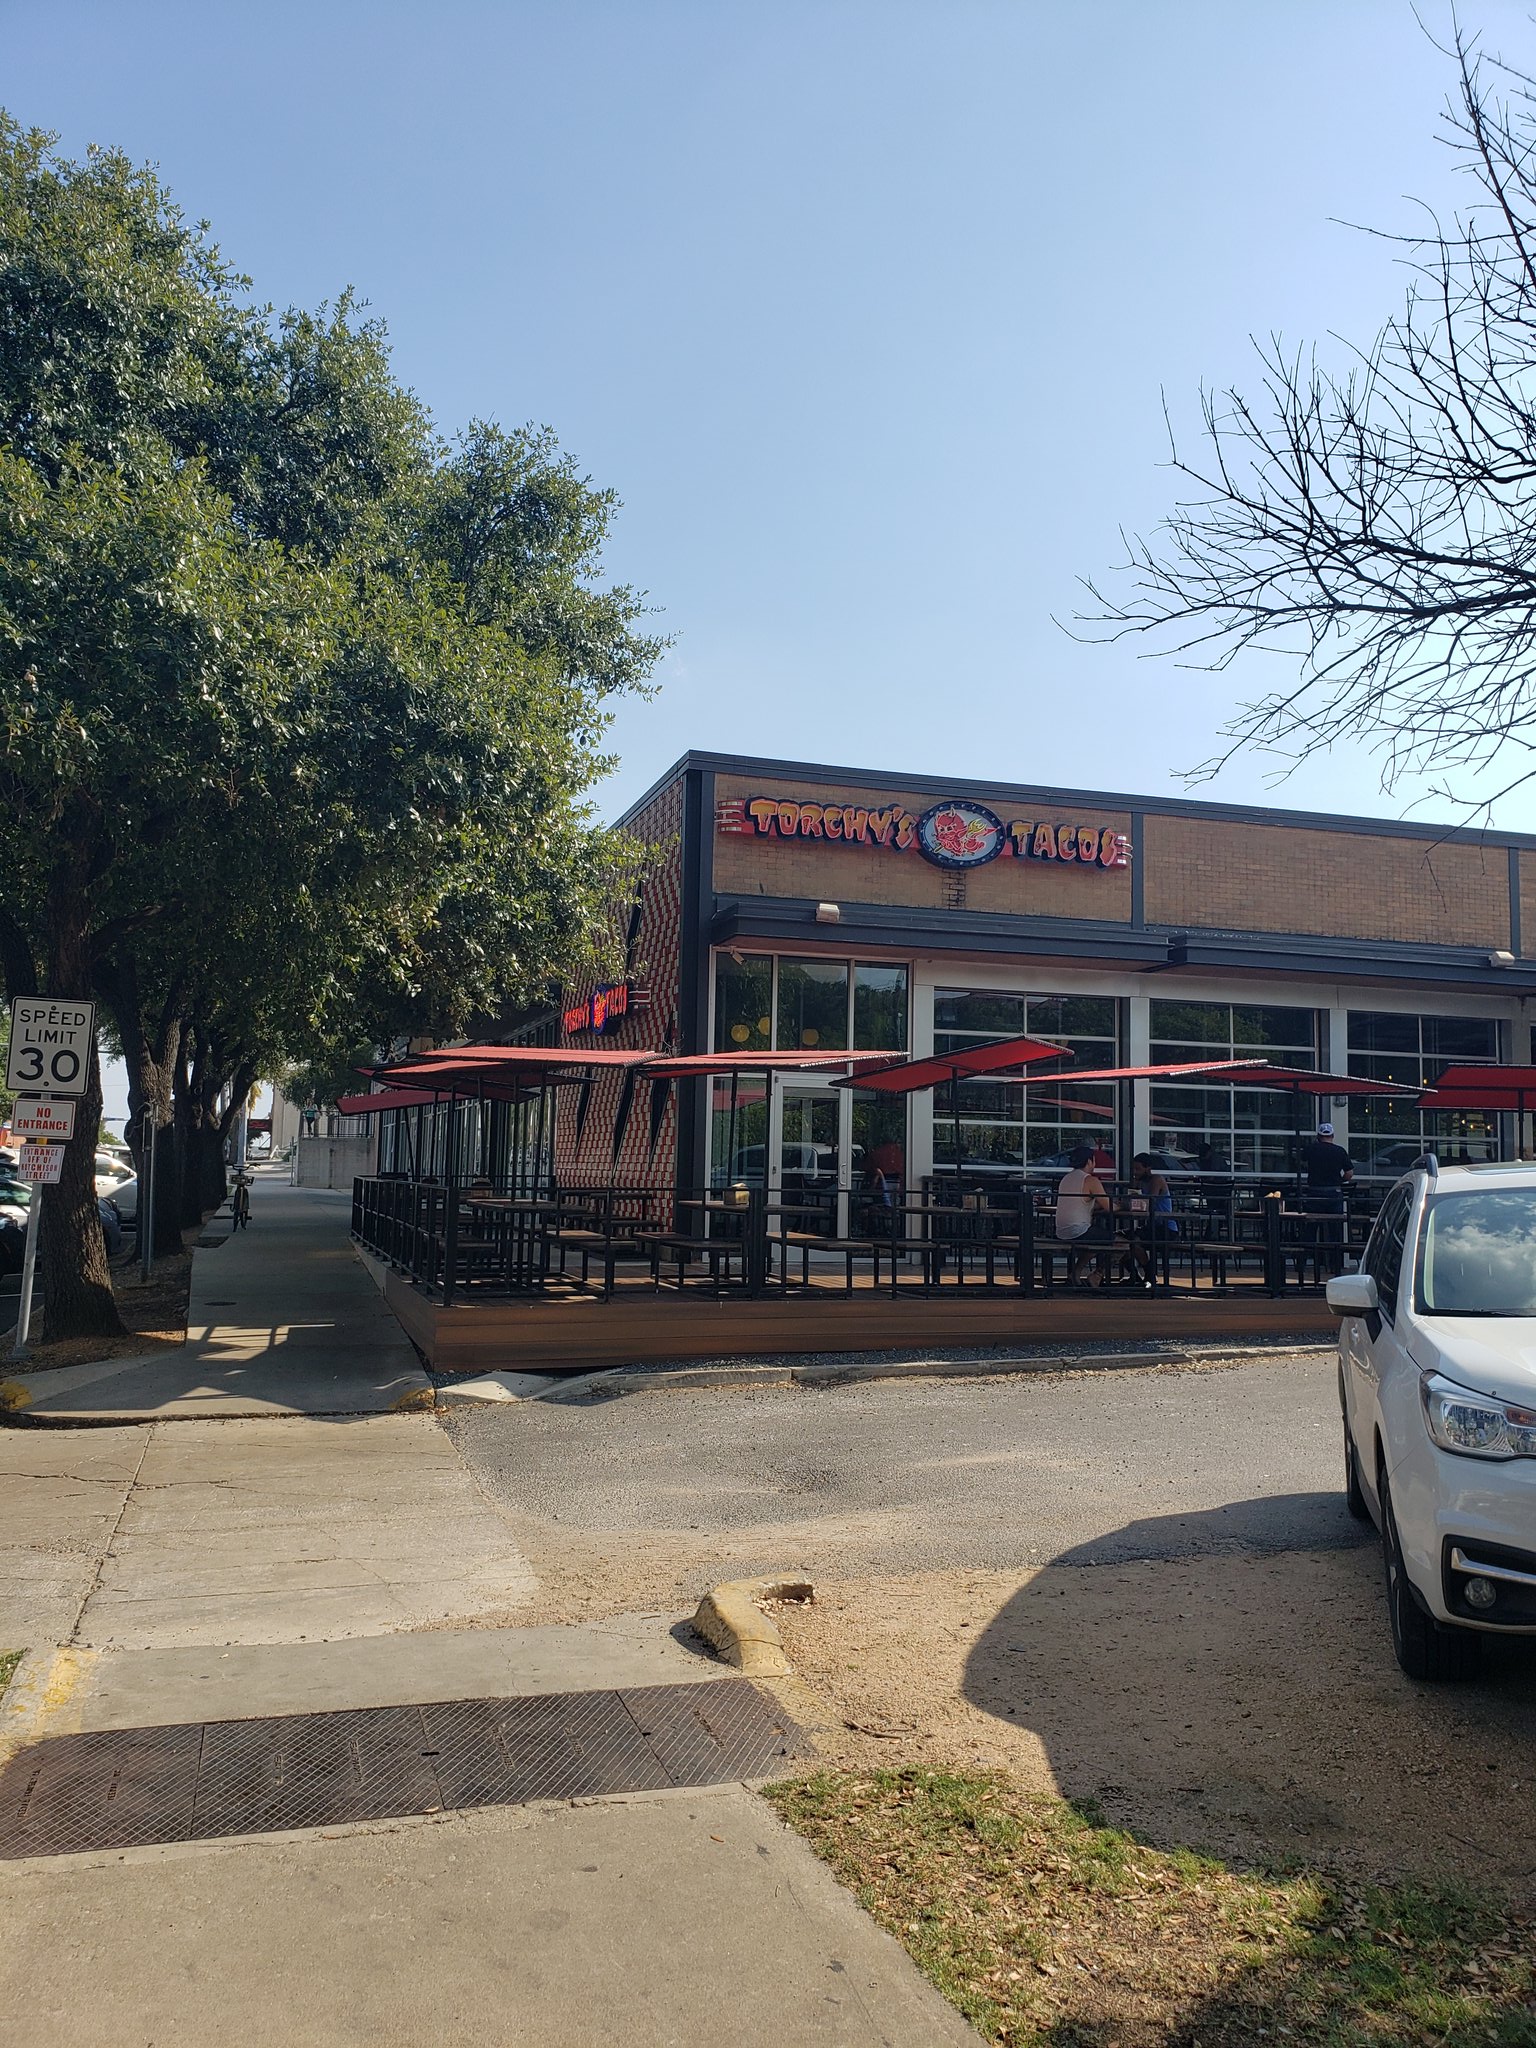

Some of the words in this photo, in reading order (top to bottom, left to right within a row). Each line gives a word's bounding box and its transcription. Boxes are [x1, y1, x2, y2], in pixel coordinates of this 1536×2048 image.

[748, 797, 917, 850] TORCHY'S
[1011, 820, 1119, 868] TACOS
[19, 1009, 86, 1026] SPEED
[25, 1028, 77, 1045] LIMIT
[16, 1047, 80, 1083] 30
[36, 1107, 52, 1118] NO
[17, 1119, 68, 1131] ENTRANCE
[24, 1147, 59, 1156] ENTRANCE
[27, 1155, 40, 1164] OFF
[43, 1156, 52, 1164] OF
[25, 1171, 50, 1179] STREET
